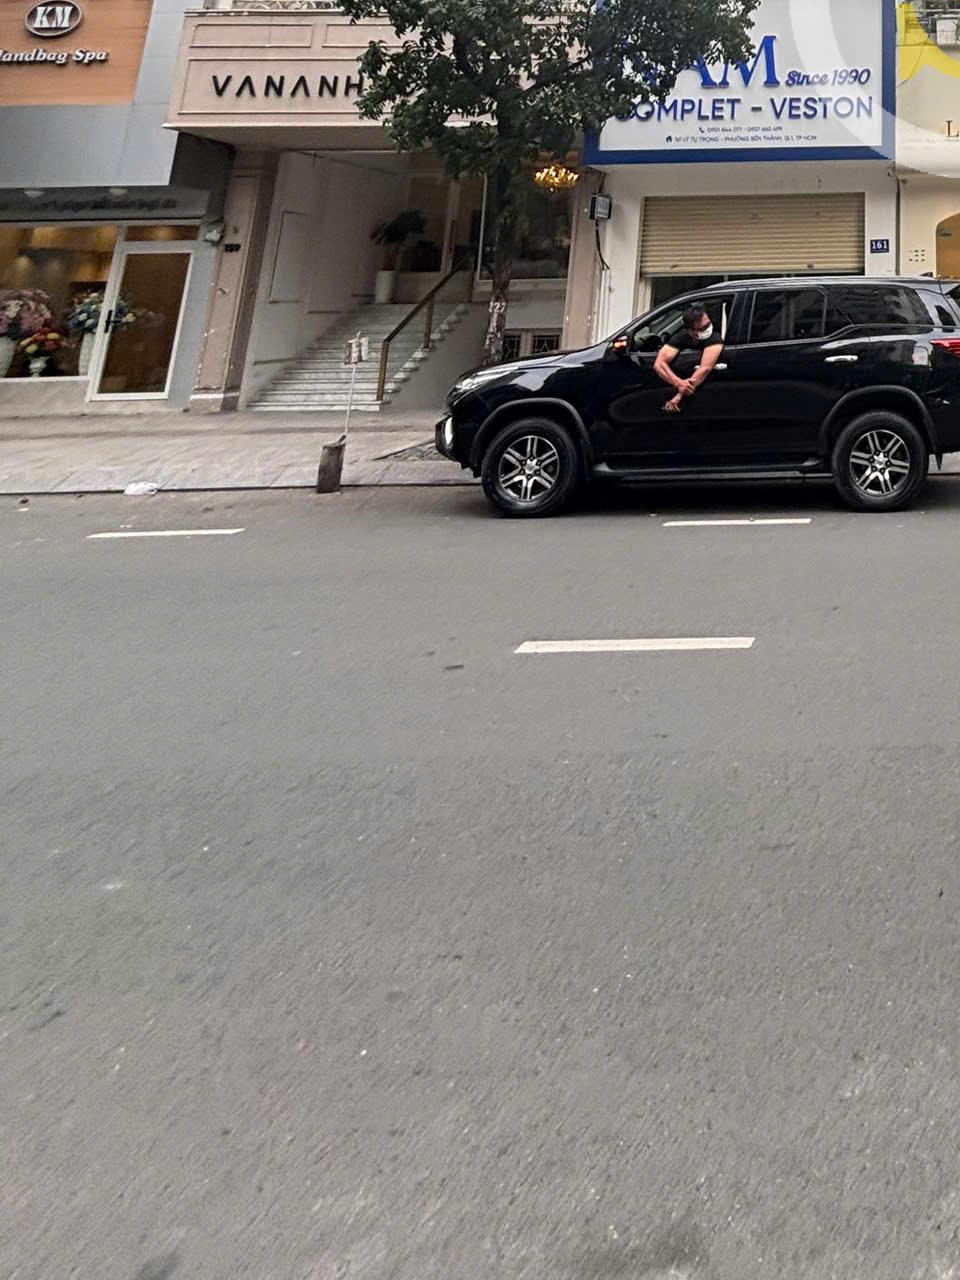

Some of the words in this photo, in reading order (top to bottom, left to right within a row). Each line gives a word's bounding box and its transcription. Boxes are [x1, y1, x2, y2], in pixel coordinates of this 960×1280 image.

[33, 6, 73, 28] KM
[72, 48, 109, 64] Spa
[212, 75, 364, 98] VANANH
[770, 96, 873, 120] VESTON
[871, 241, 888, 249] 161
